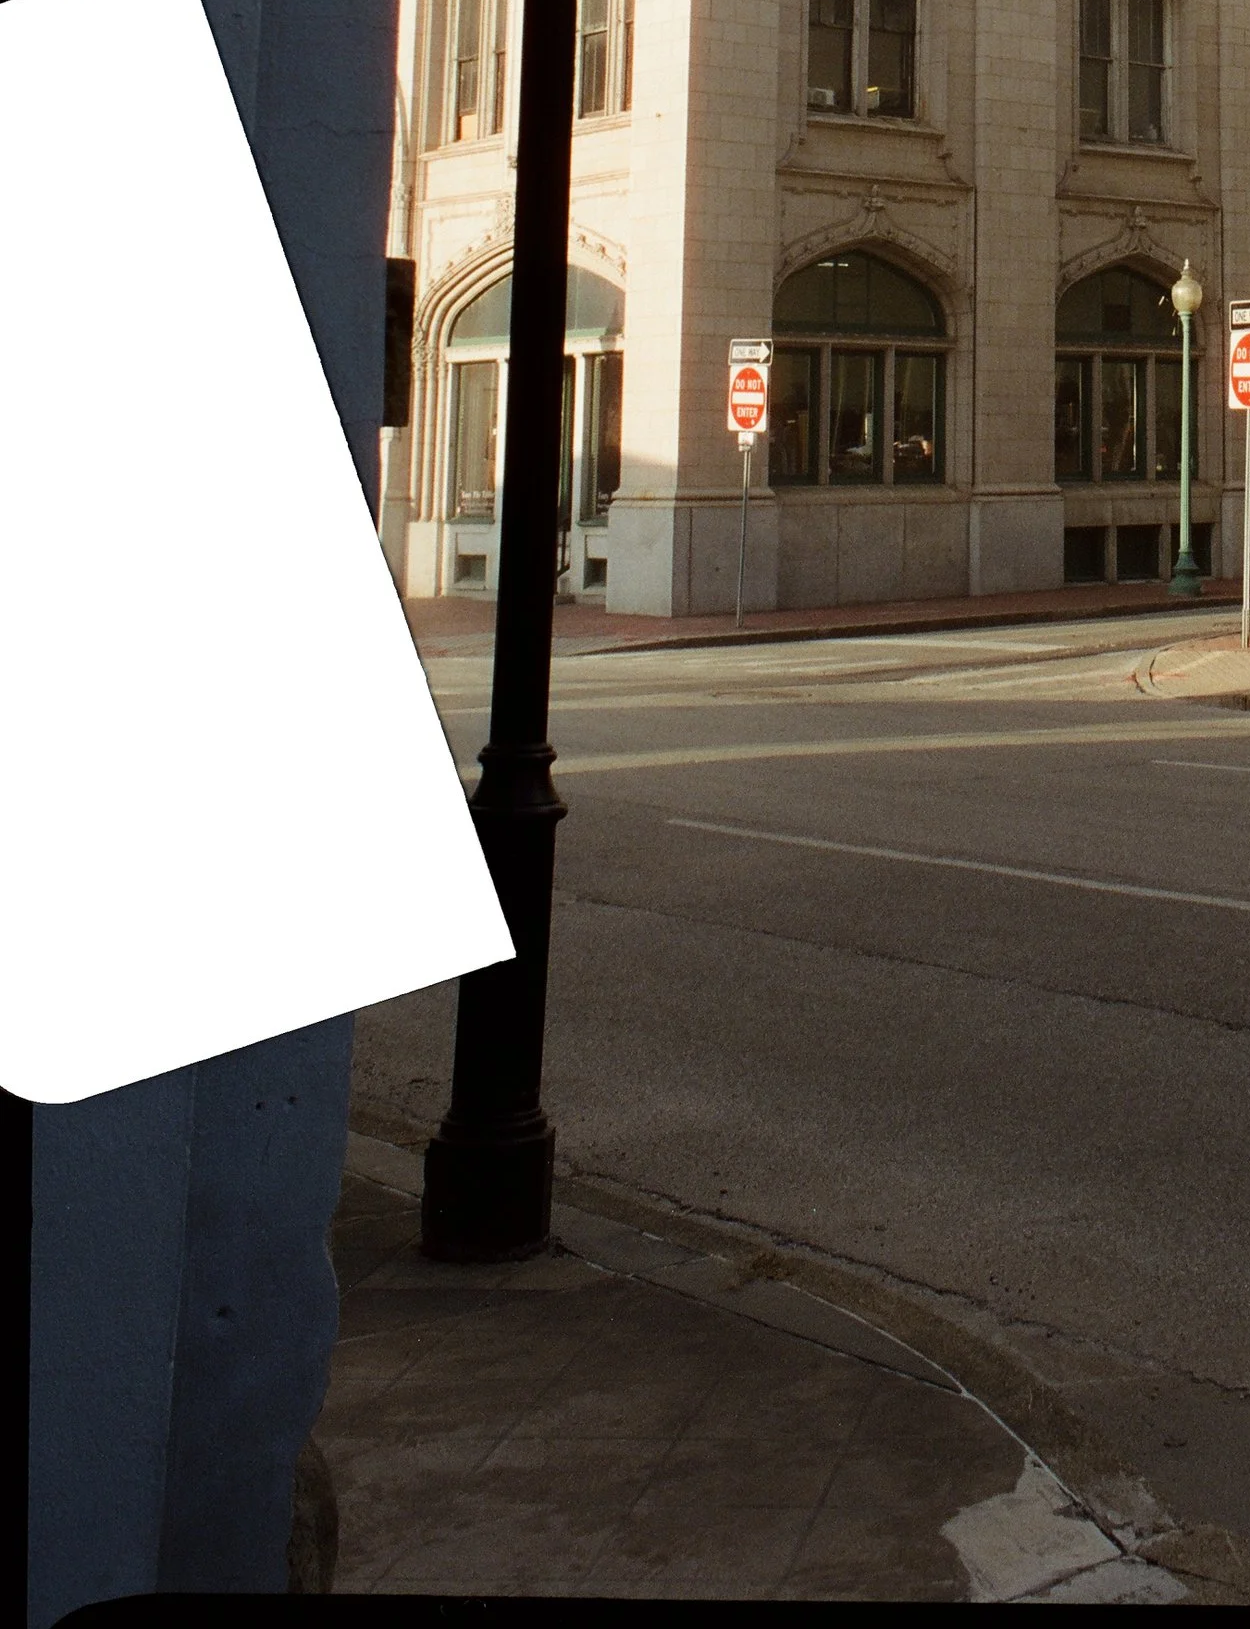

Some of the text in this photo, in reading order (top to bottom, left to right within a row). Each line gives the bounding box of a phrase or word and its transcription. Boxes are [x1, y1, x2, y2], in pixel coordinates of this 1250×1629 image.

[1234, 310, 1247, 322] ONE
[1236, 347, 1247, 360] DO
[735, 379, 761, 390] DO NOT
[736, 406, 758, 418] ENTER
